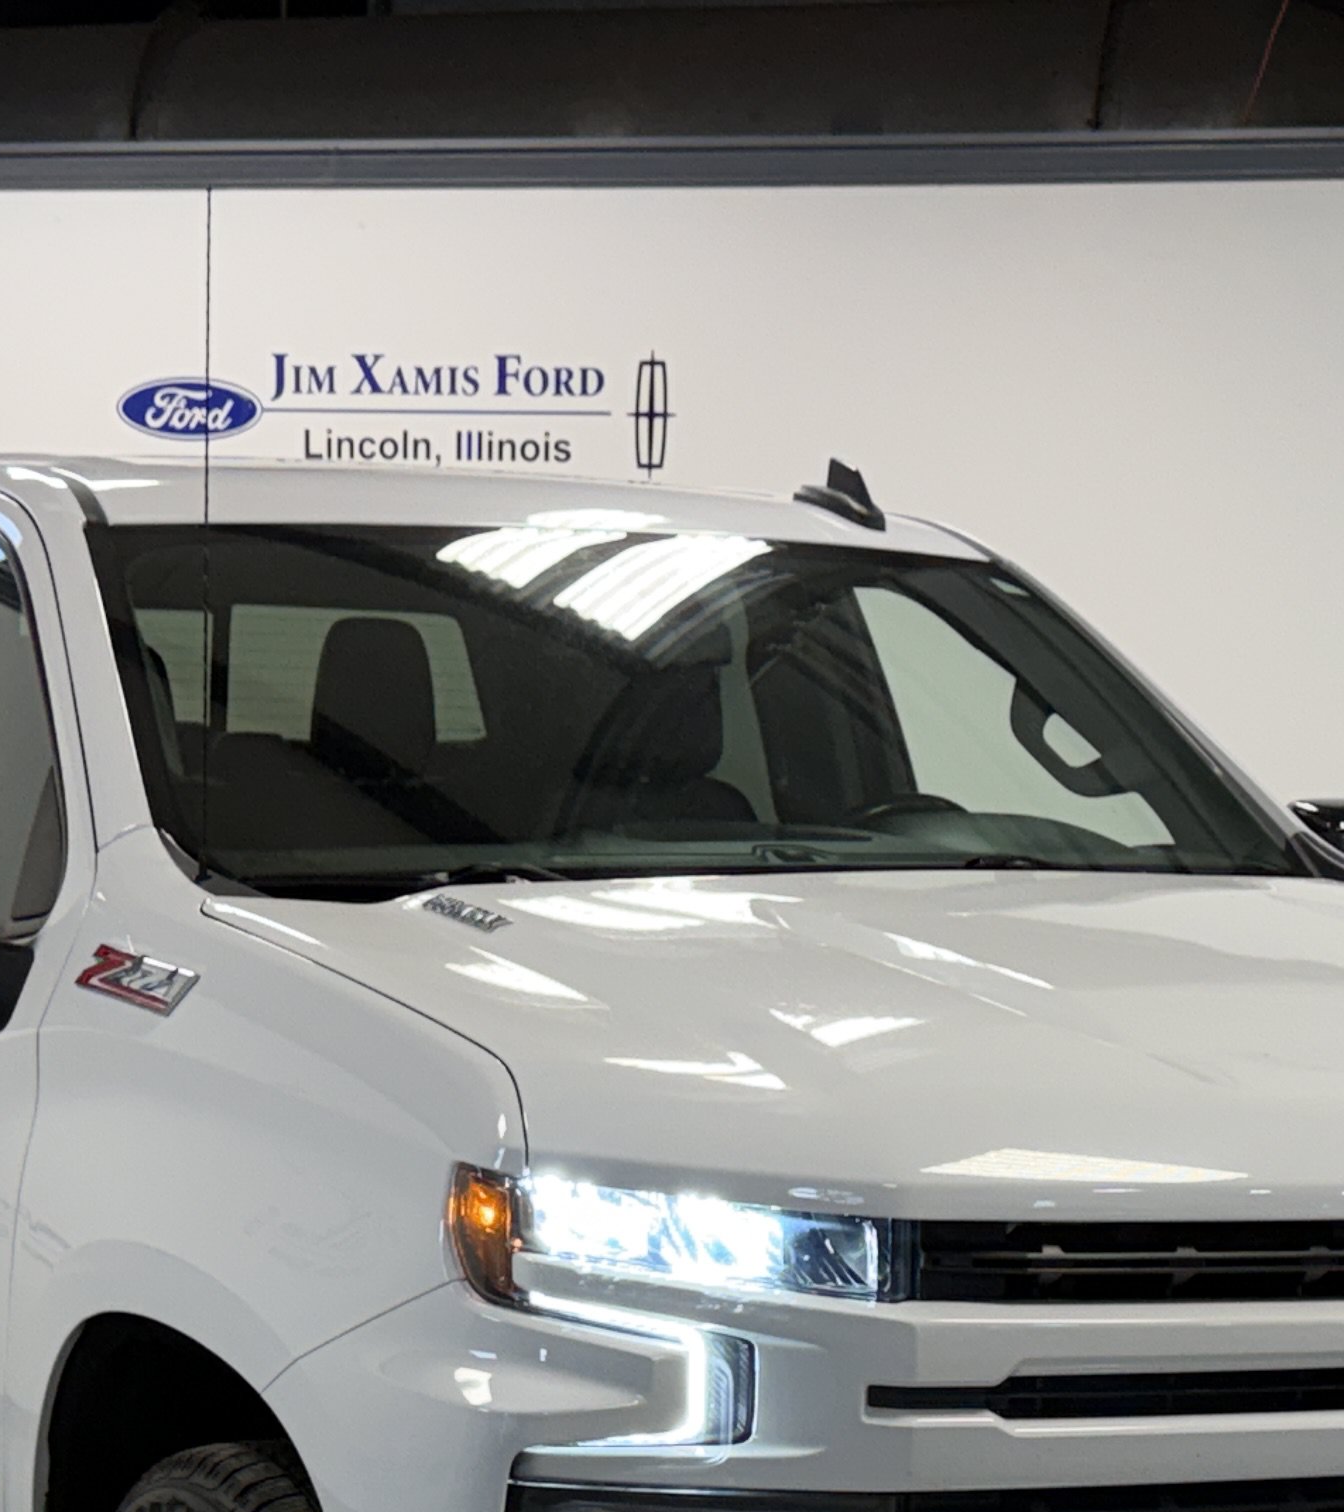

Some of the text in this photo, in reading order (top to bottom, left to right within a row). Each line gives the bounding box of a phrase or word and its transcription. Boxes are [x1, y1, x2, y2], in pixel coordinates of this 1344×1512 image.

[272, 353, 605, 400] JIM XAMIS FORD
[145, 386, 233, 431] Ford
[304, 429, 572, 467] Lincoln, Illinois
